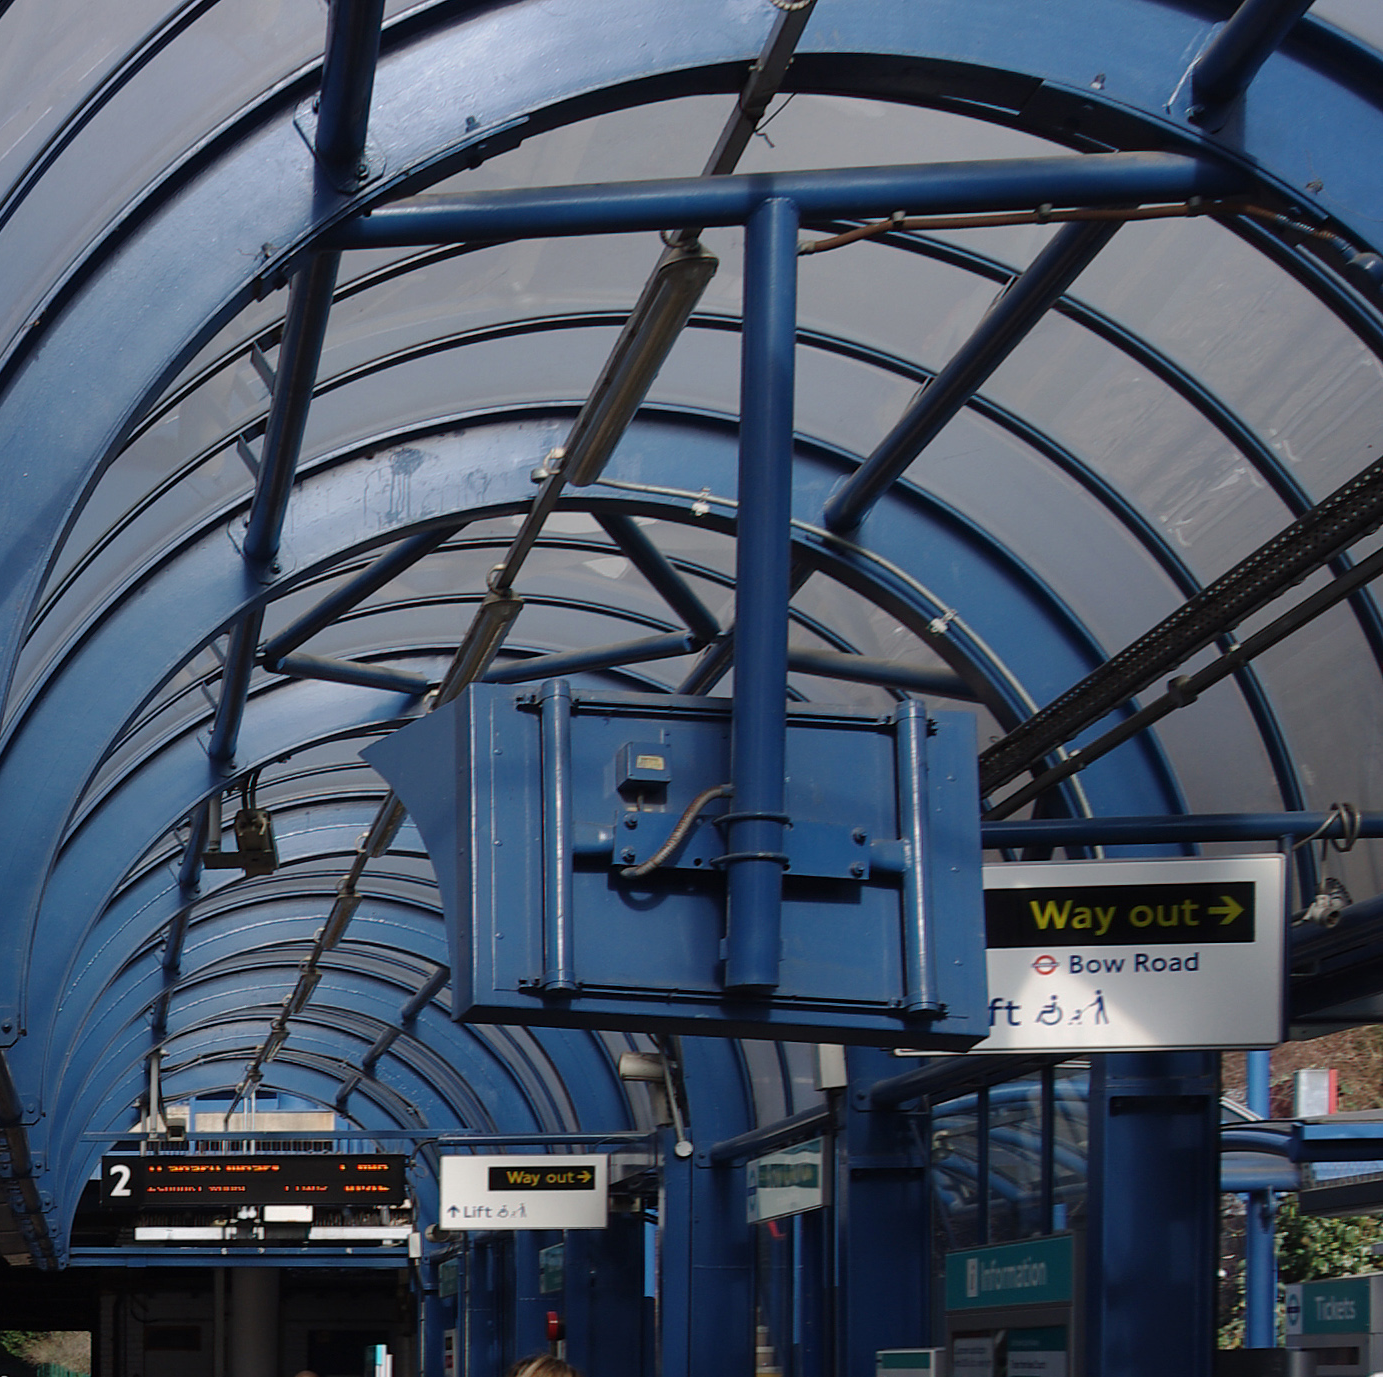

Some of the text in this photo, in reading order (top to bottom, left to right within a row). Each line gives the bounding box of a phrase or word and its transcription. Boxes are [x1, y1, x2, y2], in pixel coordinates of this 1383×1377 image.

[1029, 899, 1201, 936] Way out
[1069, 952, 1200, 974] Bow Road
[987, 998, 1021, 1026] ft
[108, 1163, 133, 1198] 2
[506, 1170, 575, 1187] Way out
[463, 1205, 492, 1218] Lift
[980, 1256, 1048, 1292] Information
[1314, 1295, 1356, 1321] Tickets
